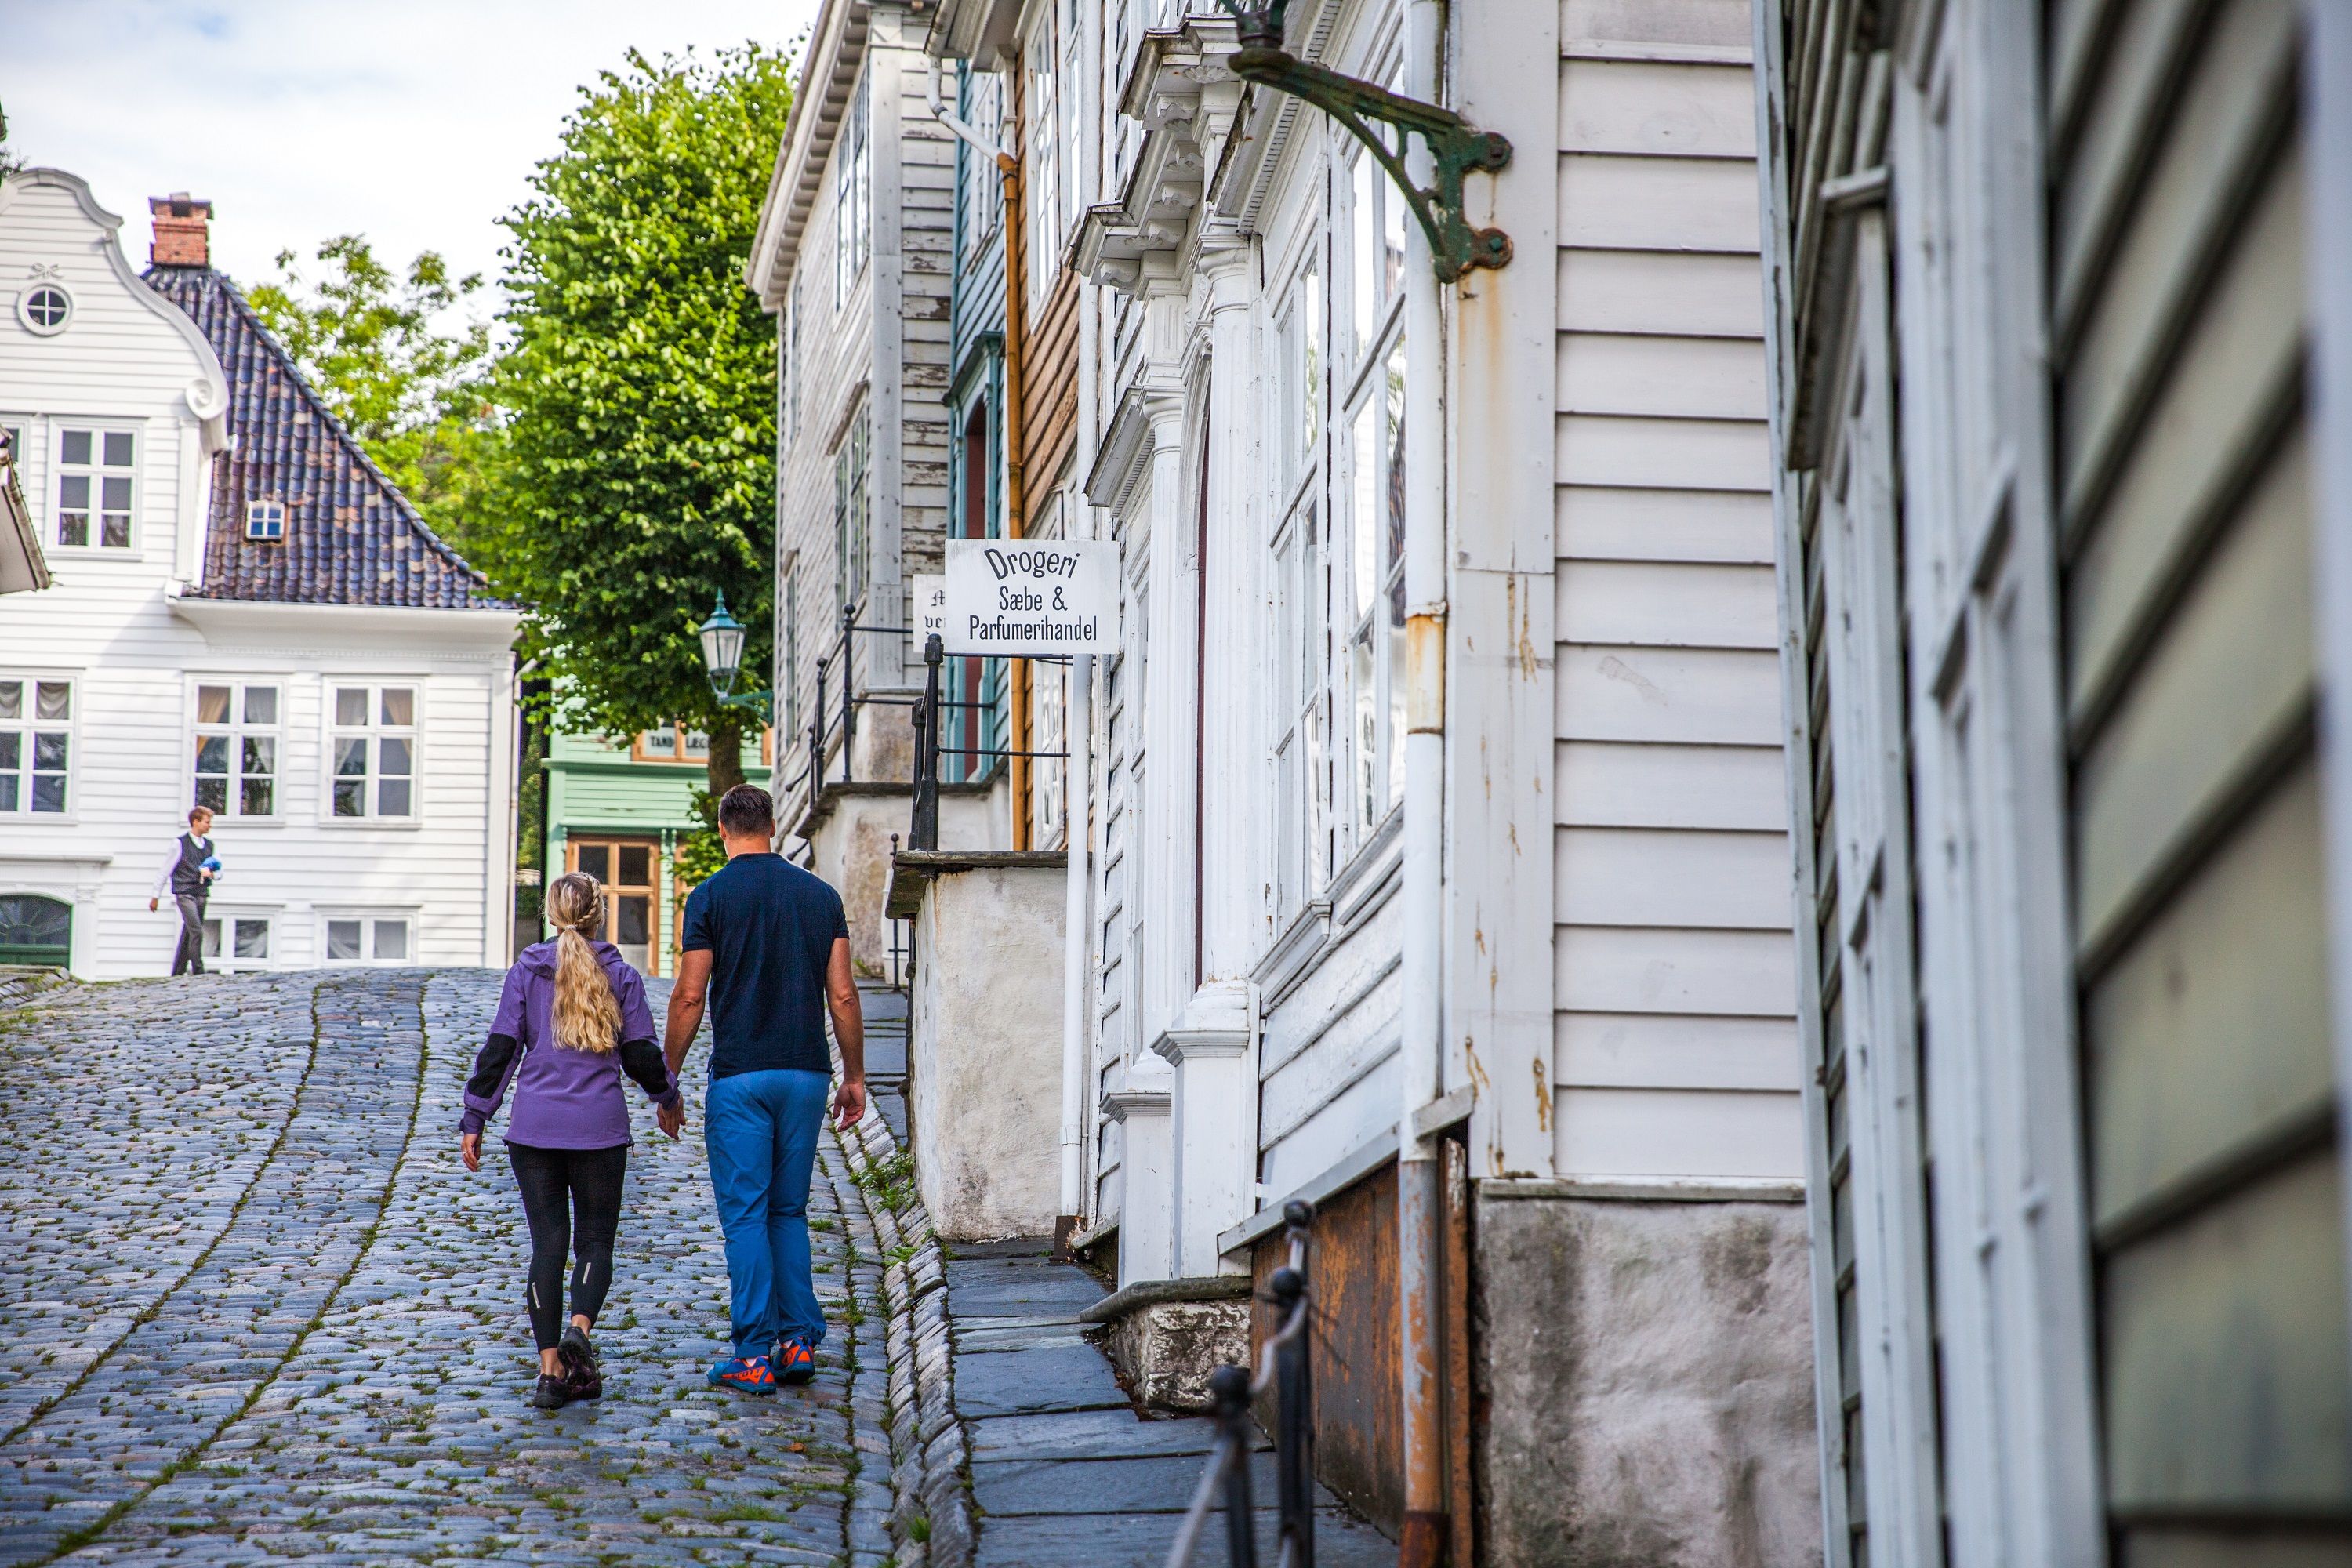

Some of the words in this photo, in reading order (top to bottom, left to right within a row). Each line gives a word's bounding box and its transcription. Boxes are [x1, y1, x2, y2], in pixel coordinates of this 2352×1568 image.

[984, 548, 1080, 580] Drogeri
[999, 585, 1043, 611] Sæbe
[1052, 586, 1068, 611] &
[969, 615, 1097, 640] Parfumerihandel
